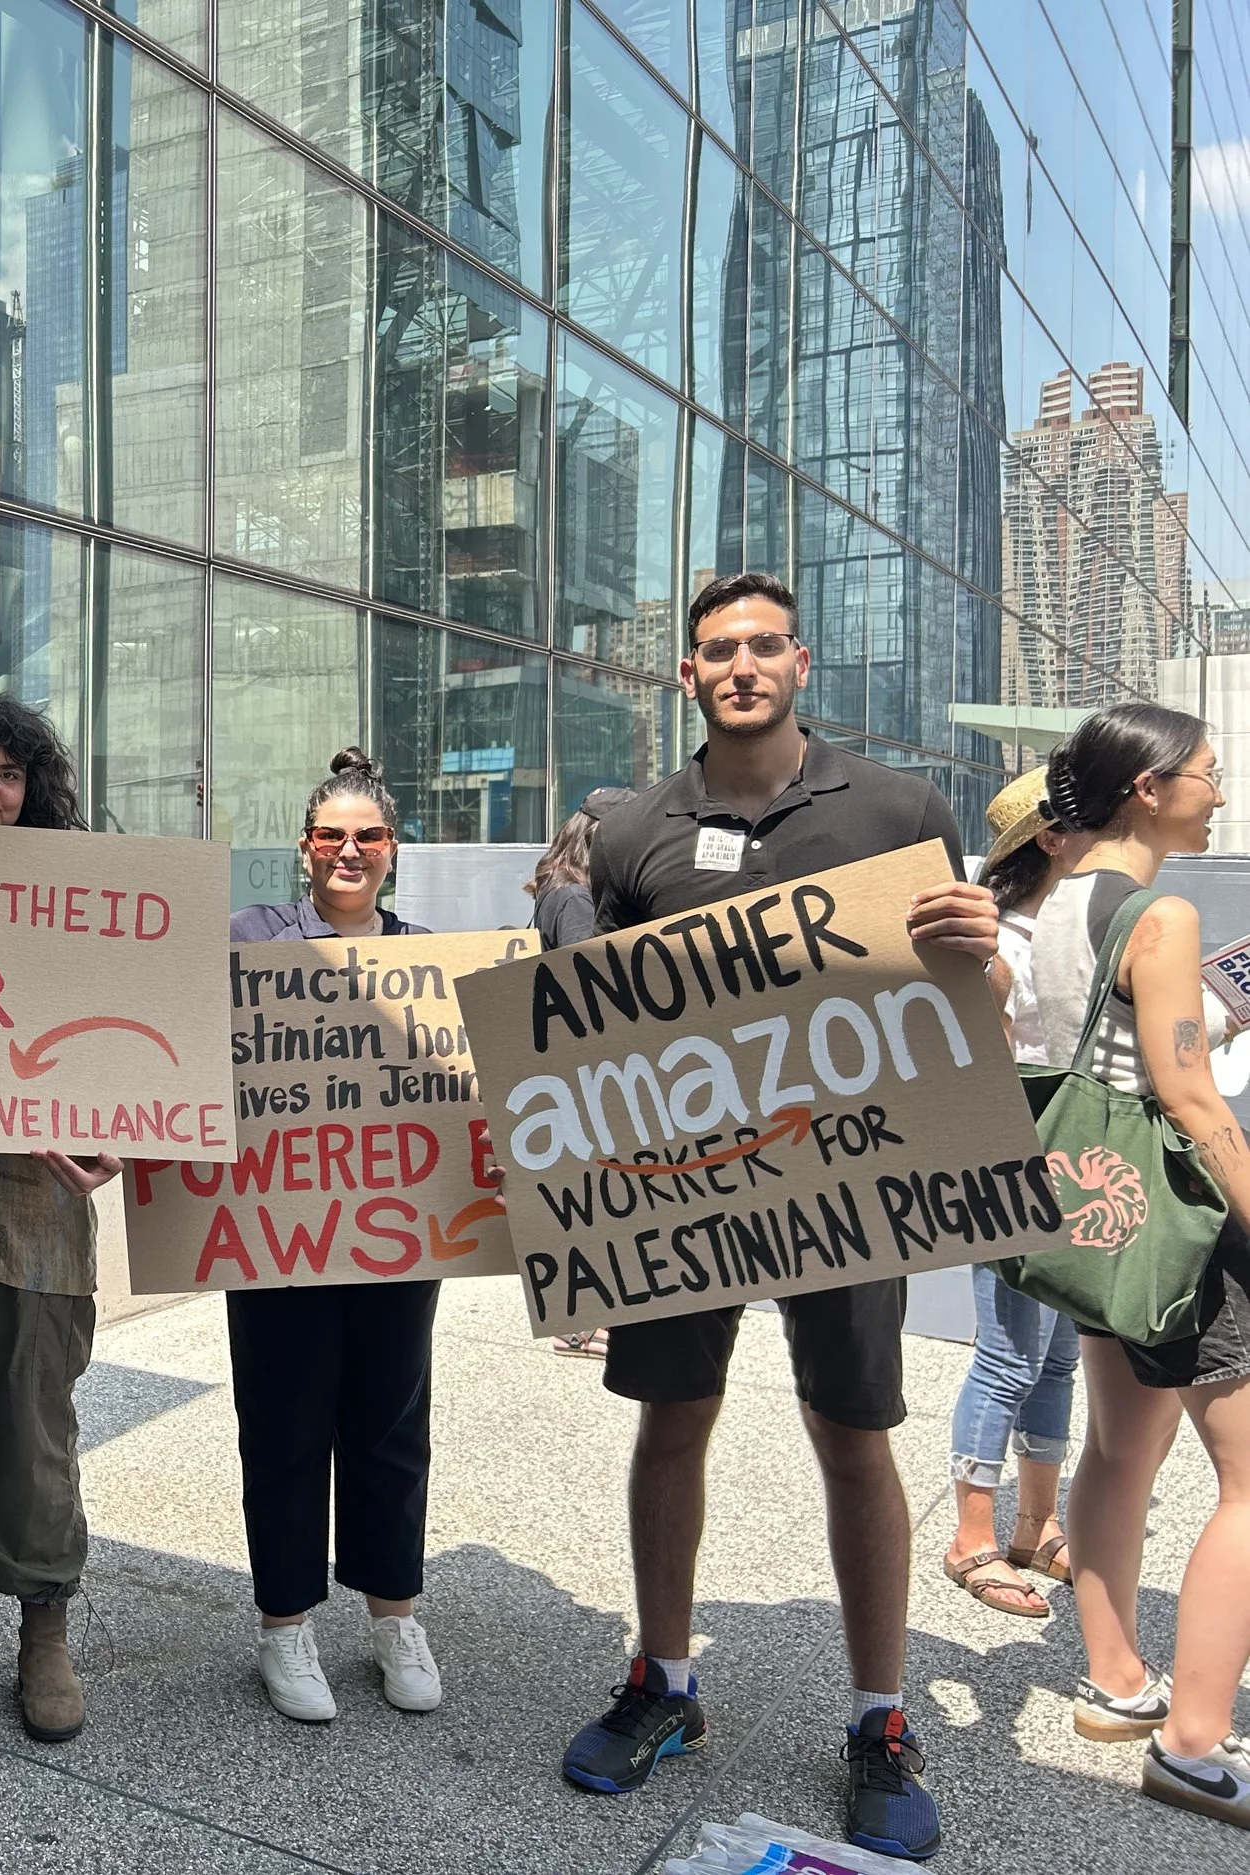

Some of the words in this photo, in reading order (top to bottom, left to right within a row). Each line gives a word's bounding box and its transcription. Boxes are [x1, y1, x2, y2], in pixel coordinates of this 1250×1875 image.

[532, 885, 868, 1053] ANOTHER
[234, 1080, 309, 1120] ives
[326, 1074, 361, 1111] in
[505, 981, 973, 1170] amazon
[194, 1197, 422, 1282] AWS
[525, 1181, 872, 1322] PALESTINIAN
[876, 1155, 1063, 1261] RIGHTS
[537, 1127, 784, 1232] WORKER
[810, 1105, 904, 1166] FOR
